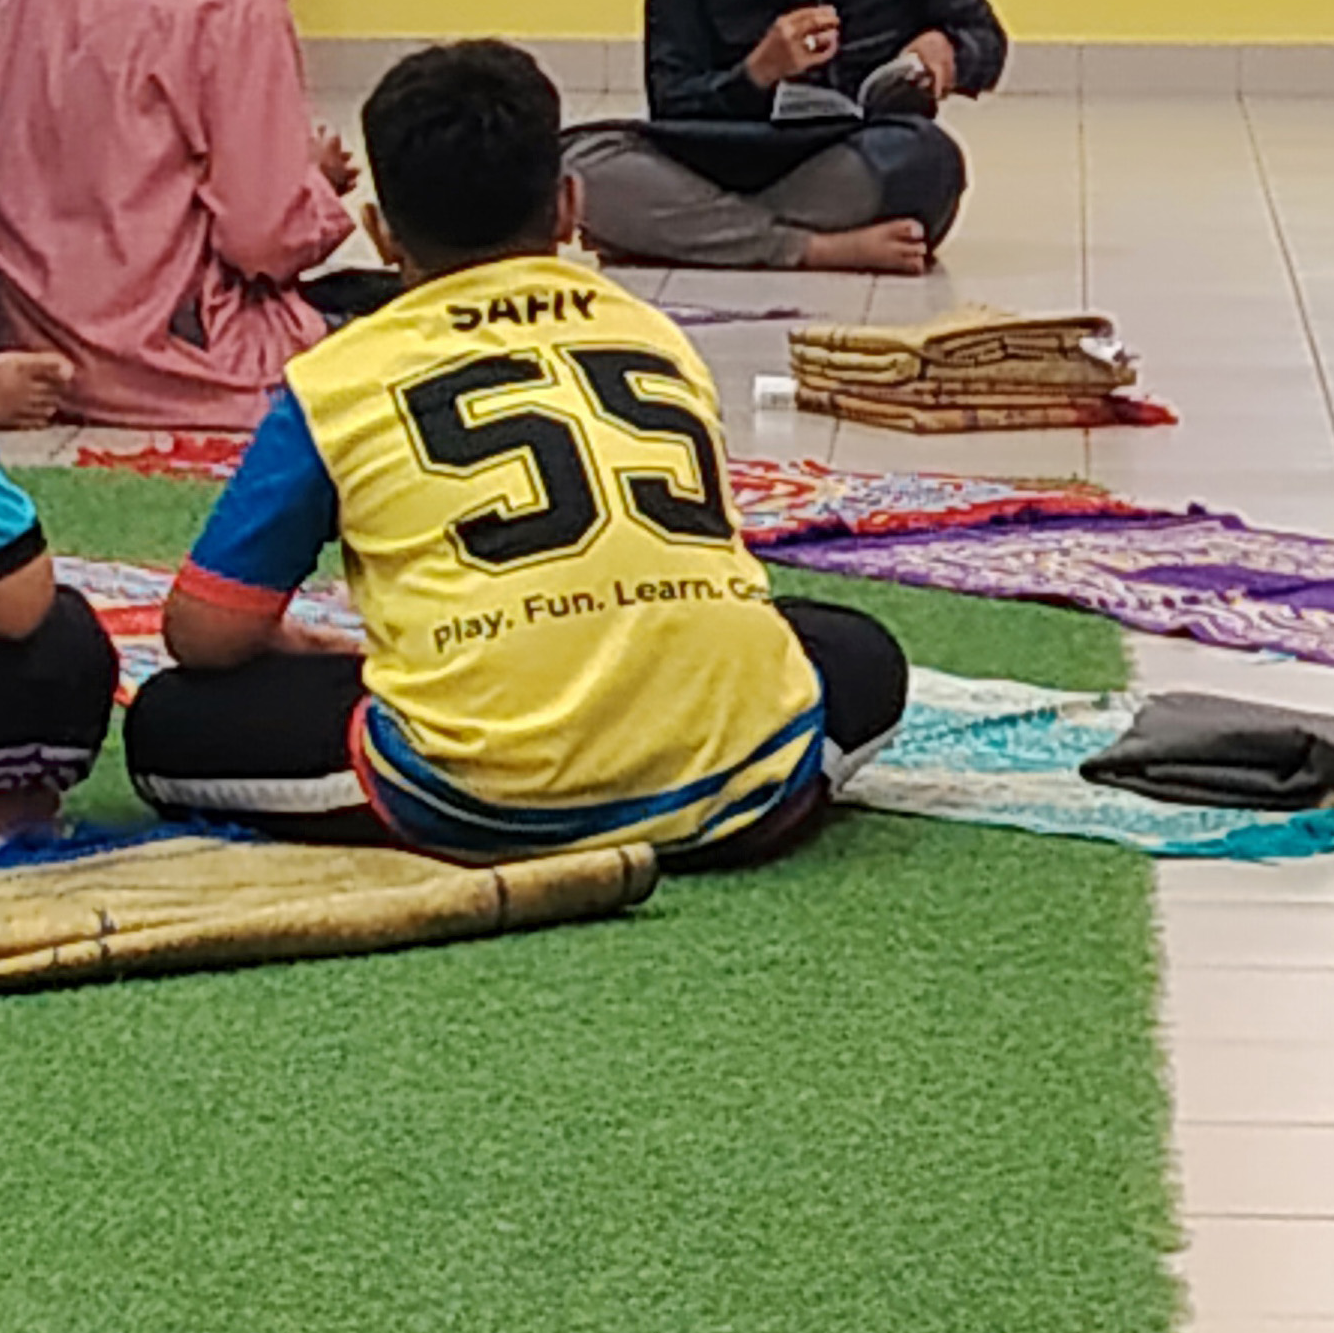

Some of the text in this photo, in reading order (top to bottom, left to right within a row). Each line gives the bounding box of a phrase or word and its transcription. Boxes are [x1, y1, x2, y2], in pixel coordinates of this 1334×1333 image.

[388, 342, 737, 575] 55
[523, 593, 605, 624] Fun.
[613, 579, 723, 607] Learn.
